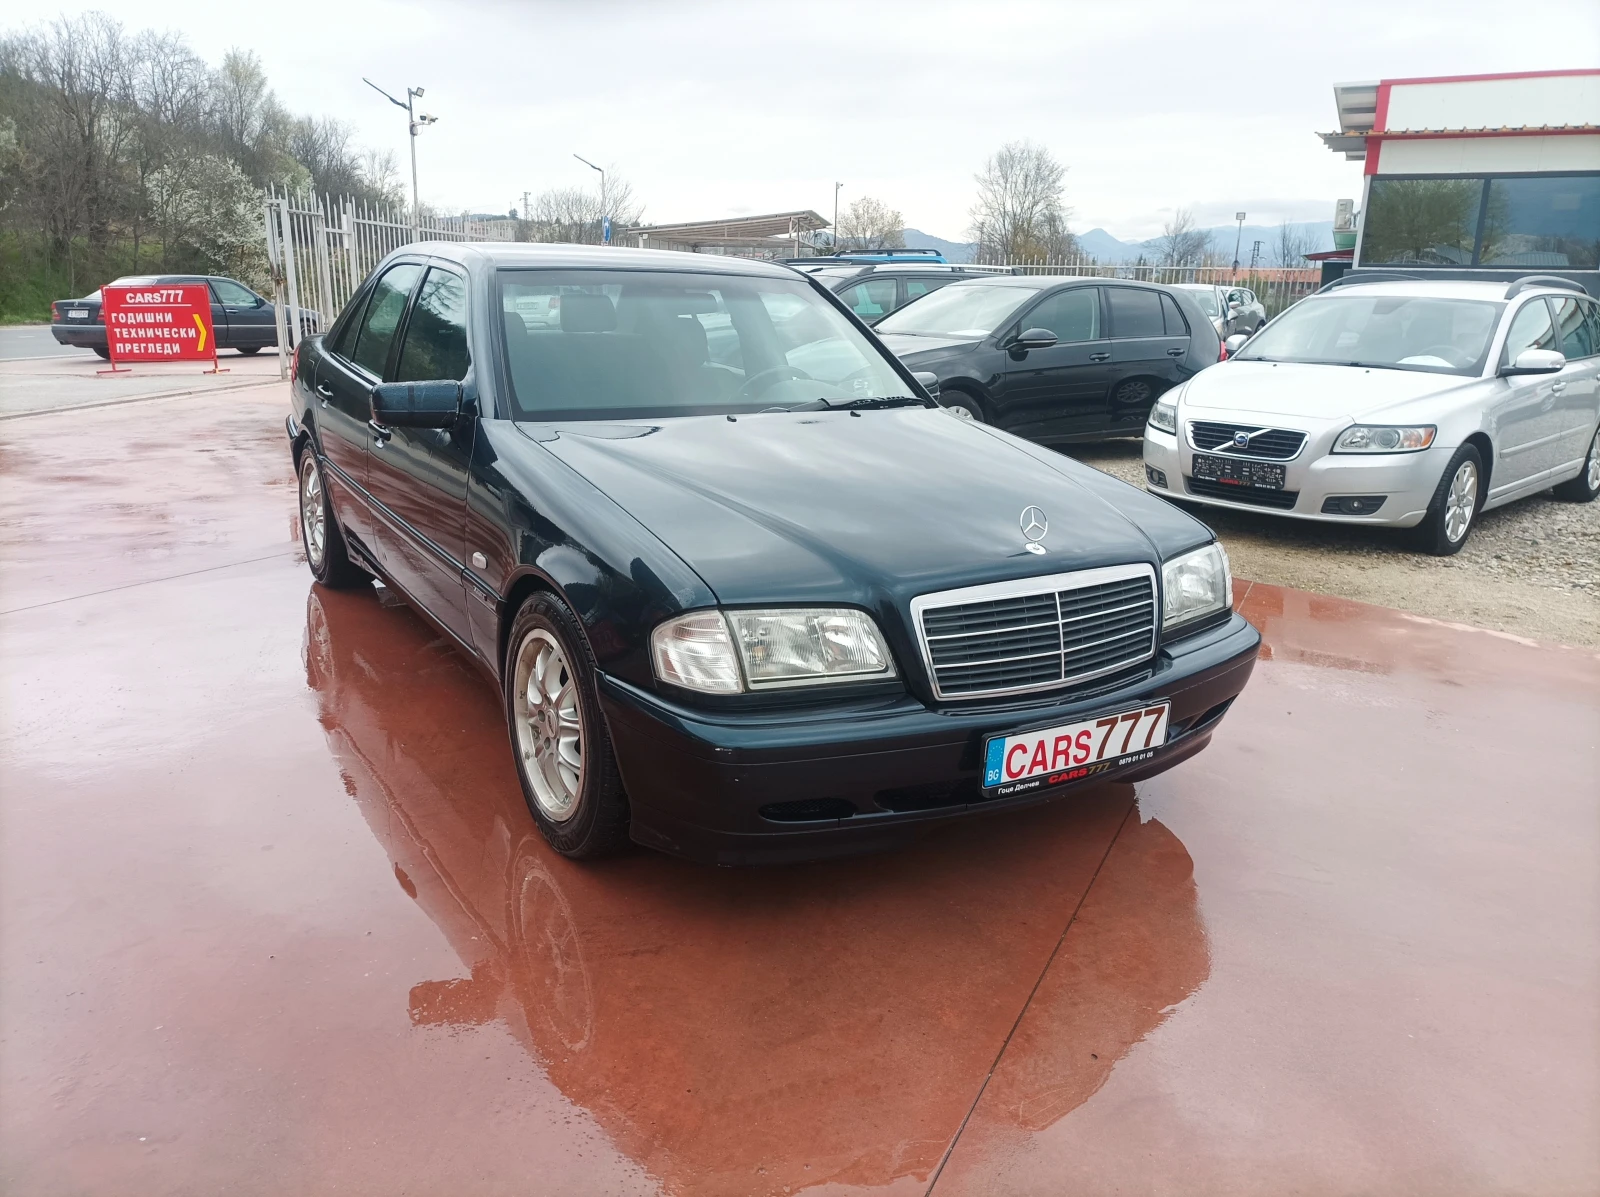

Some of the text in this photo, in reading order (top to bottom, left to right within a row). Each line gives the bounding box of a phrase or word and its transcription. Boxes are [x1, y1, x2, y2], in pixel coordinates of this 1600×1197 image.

[126, 290, 183, 303] CARS777
[111, 312, 172, 324] ГОДИШНИ
[114, 328, 196, 338] ТЕХНИЧЕСКИ
[116, 343, 180, 355] ПРЕГЛЕДИ
[1006, 706, 1165, 778] CARS777
[988, 769, 999, 781] BG
[1048, 762, 1111, 784] CARS777
[998, 786, 1014, 795] Гоце
